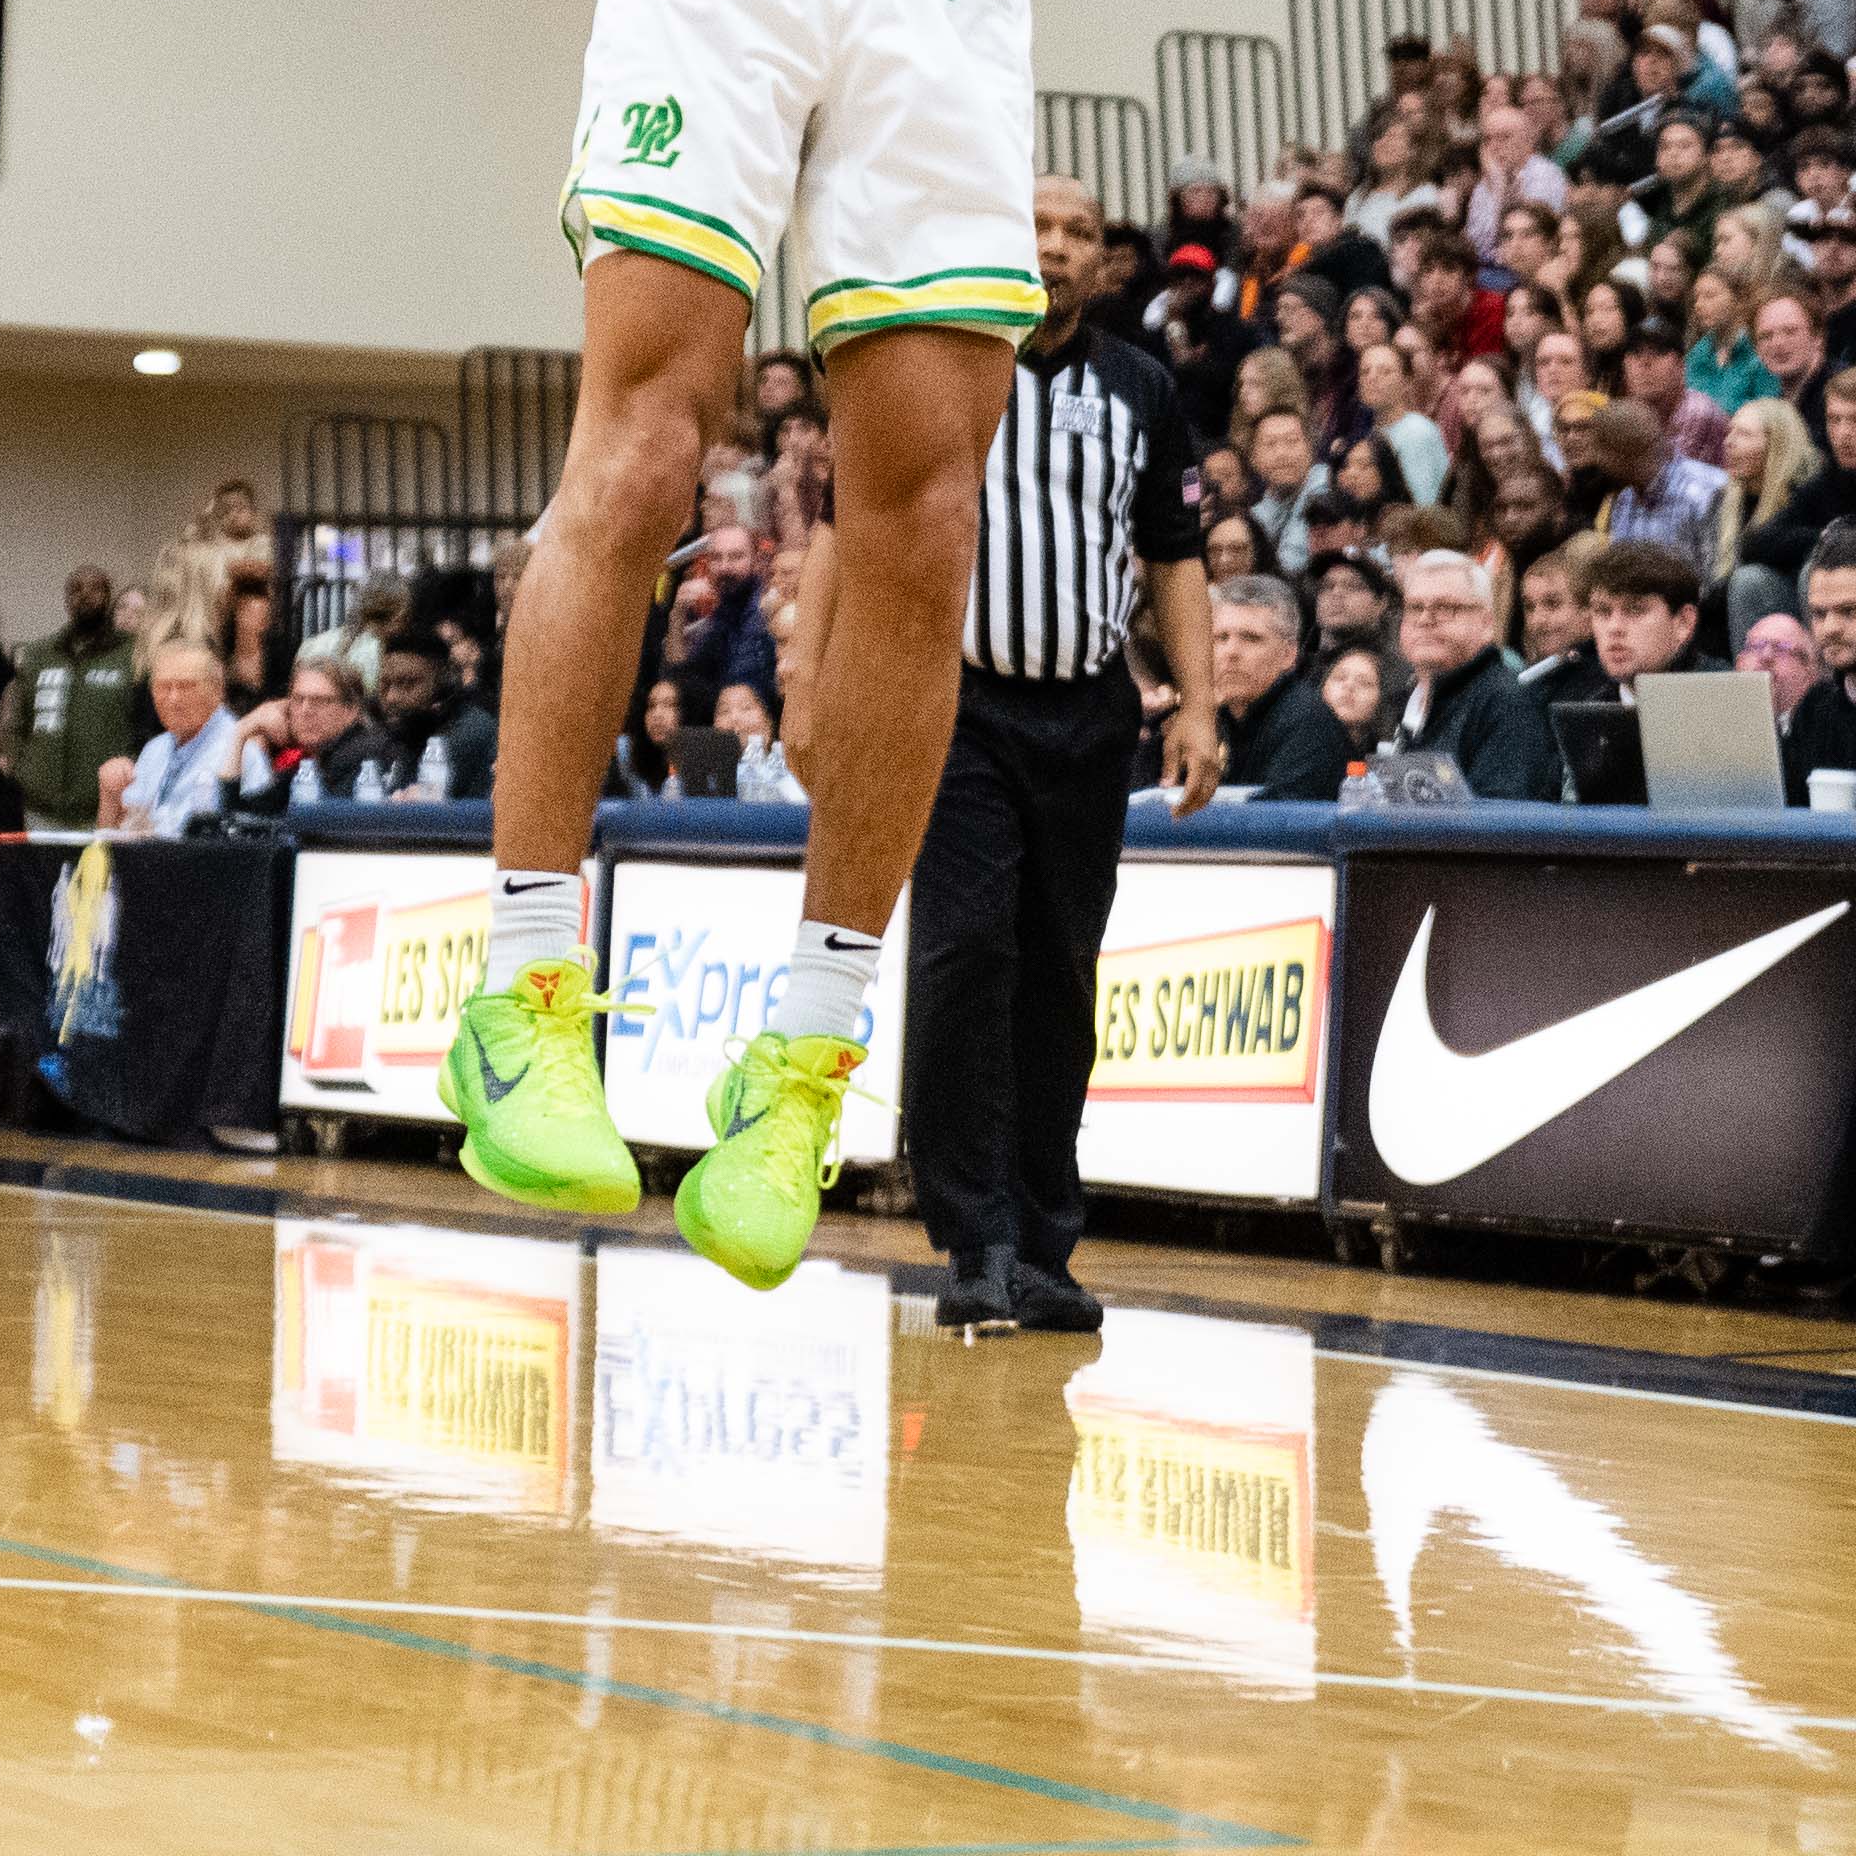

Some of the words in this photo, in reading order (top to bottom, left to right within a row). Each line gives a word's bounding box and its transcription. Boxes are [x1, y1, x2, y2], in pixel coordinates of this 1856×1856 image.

[380, 937, 428, 1024] LES
[1099, 978, 1140, 1061] ES
[1150, 960, 1305, 1059] SCHWAB
